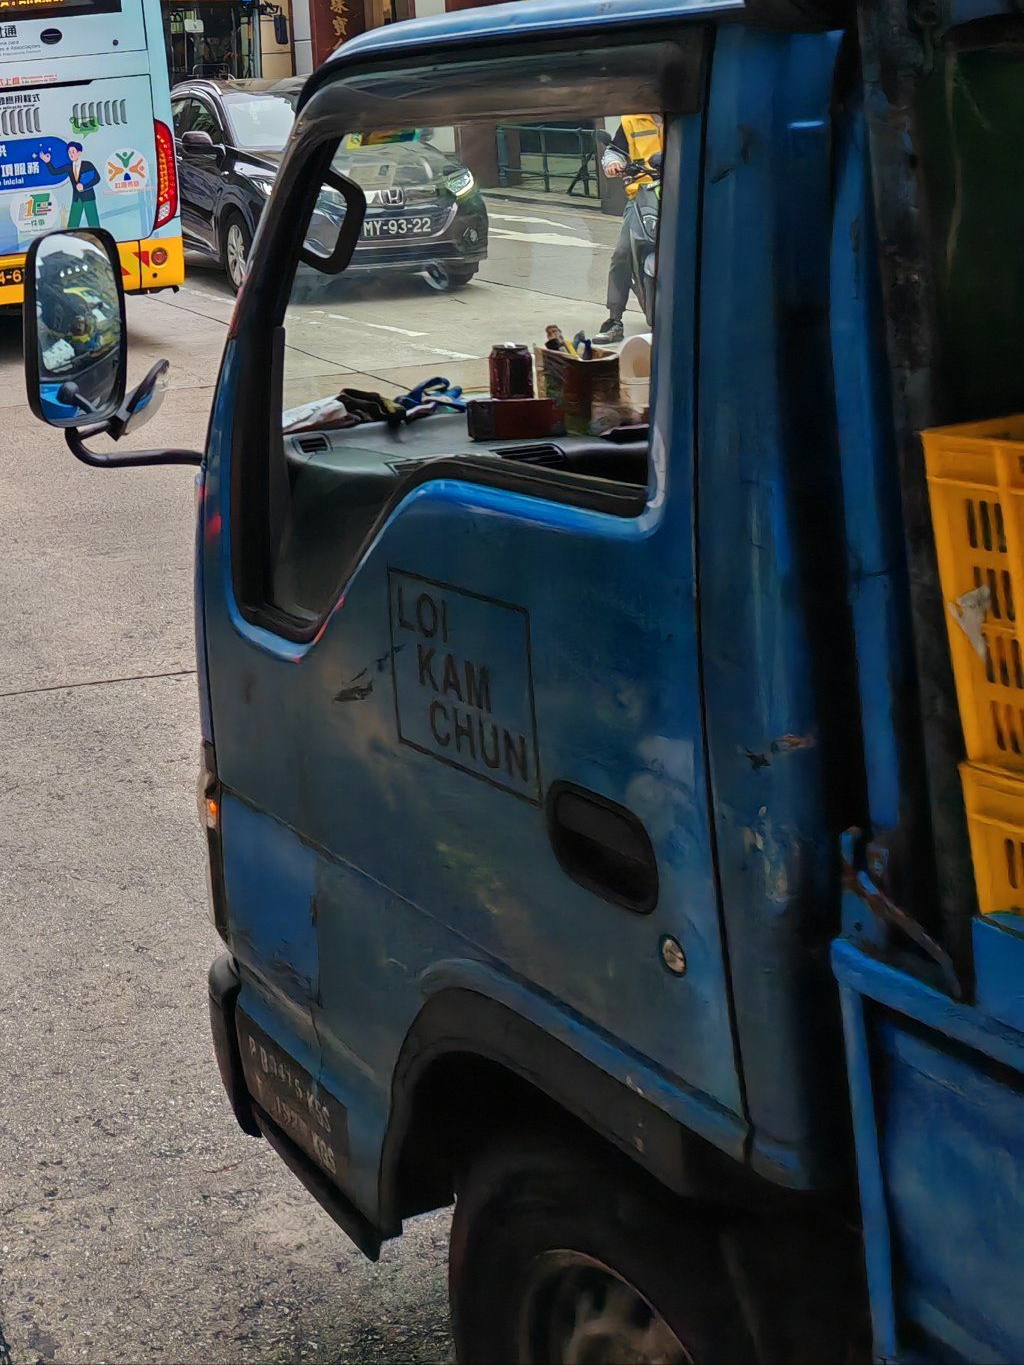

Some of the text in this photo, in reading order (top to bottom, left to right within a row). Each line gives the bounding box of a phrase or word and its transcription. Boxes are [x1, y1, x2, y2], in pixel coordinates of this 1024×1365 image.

[363, 217, 432, 237] MY-93-22
[397, 585, 448, 643] LOI
[417, 643, 491, 714] KAM
[430, 700, 528, 783] CHUN
